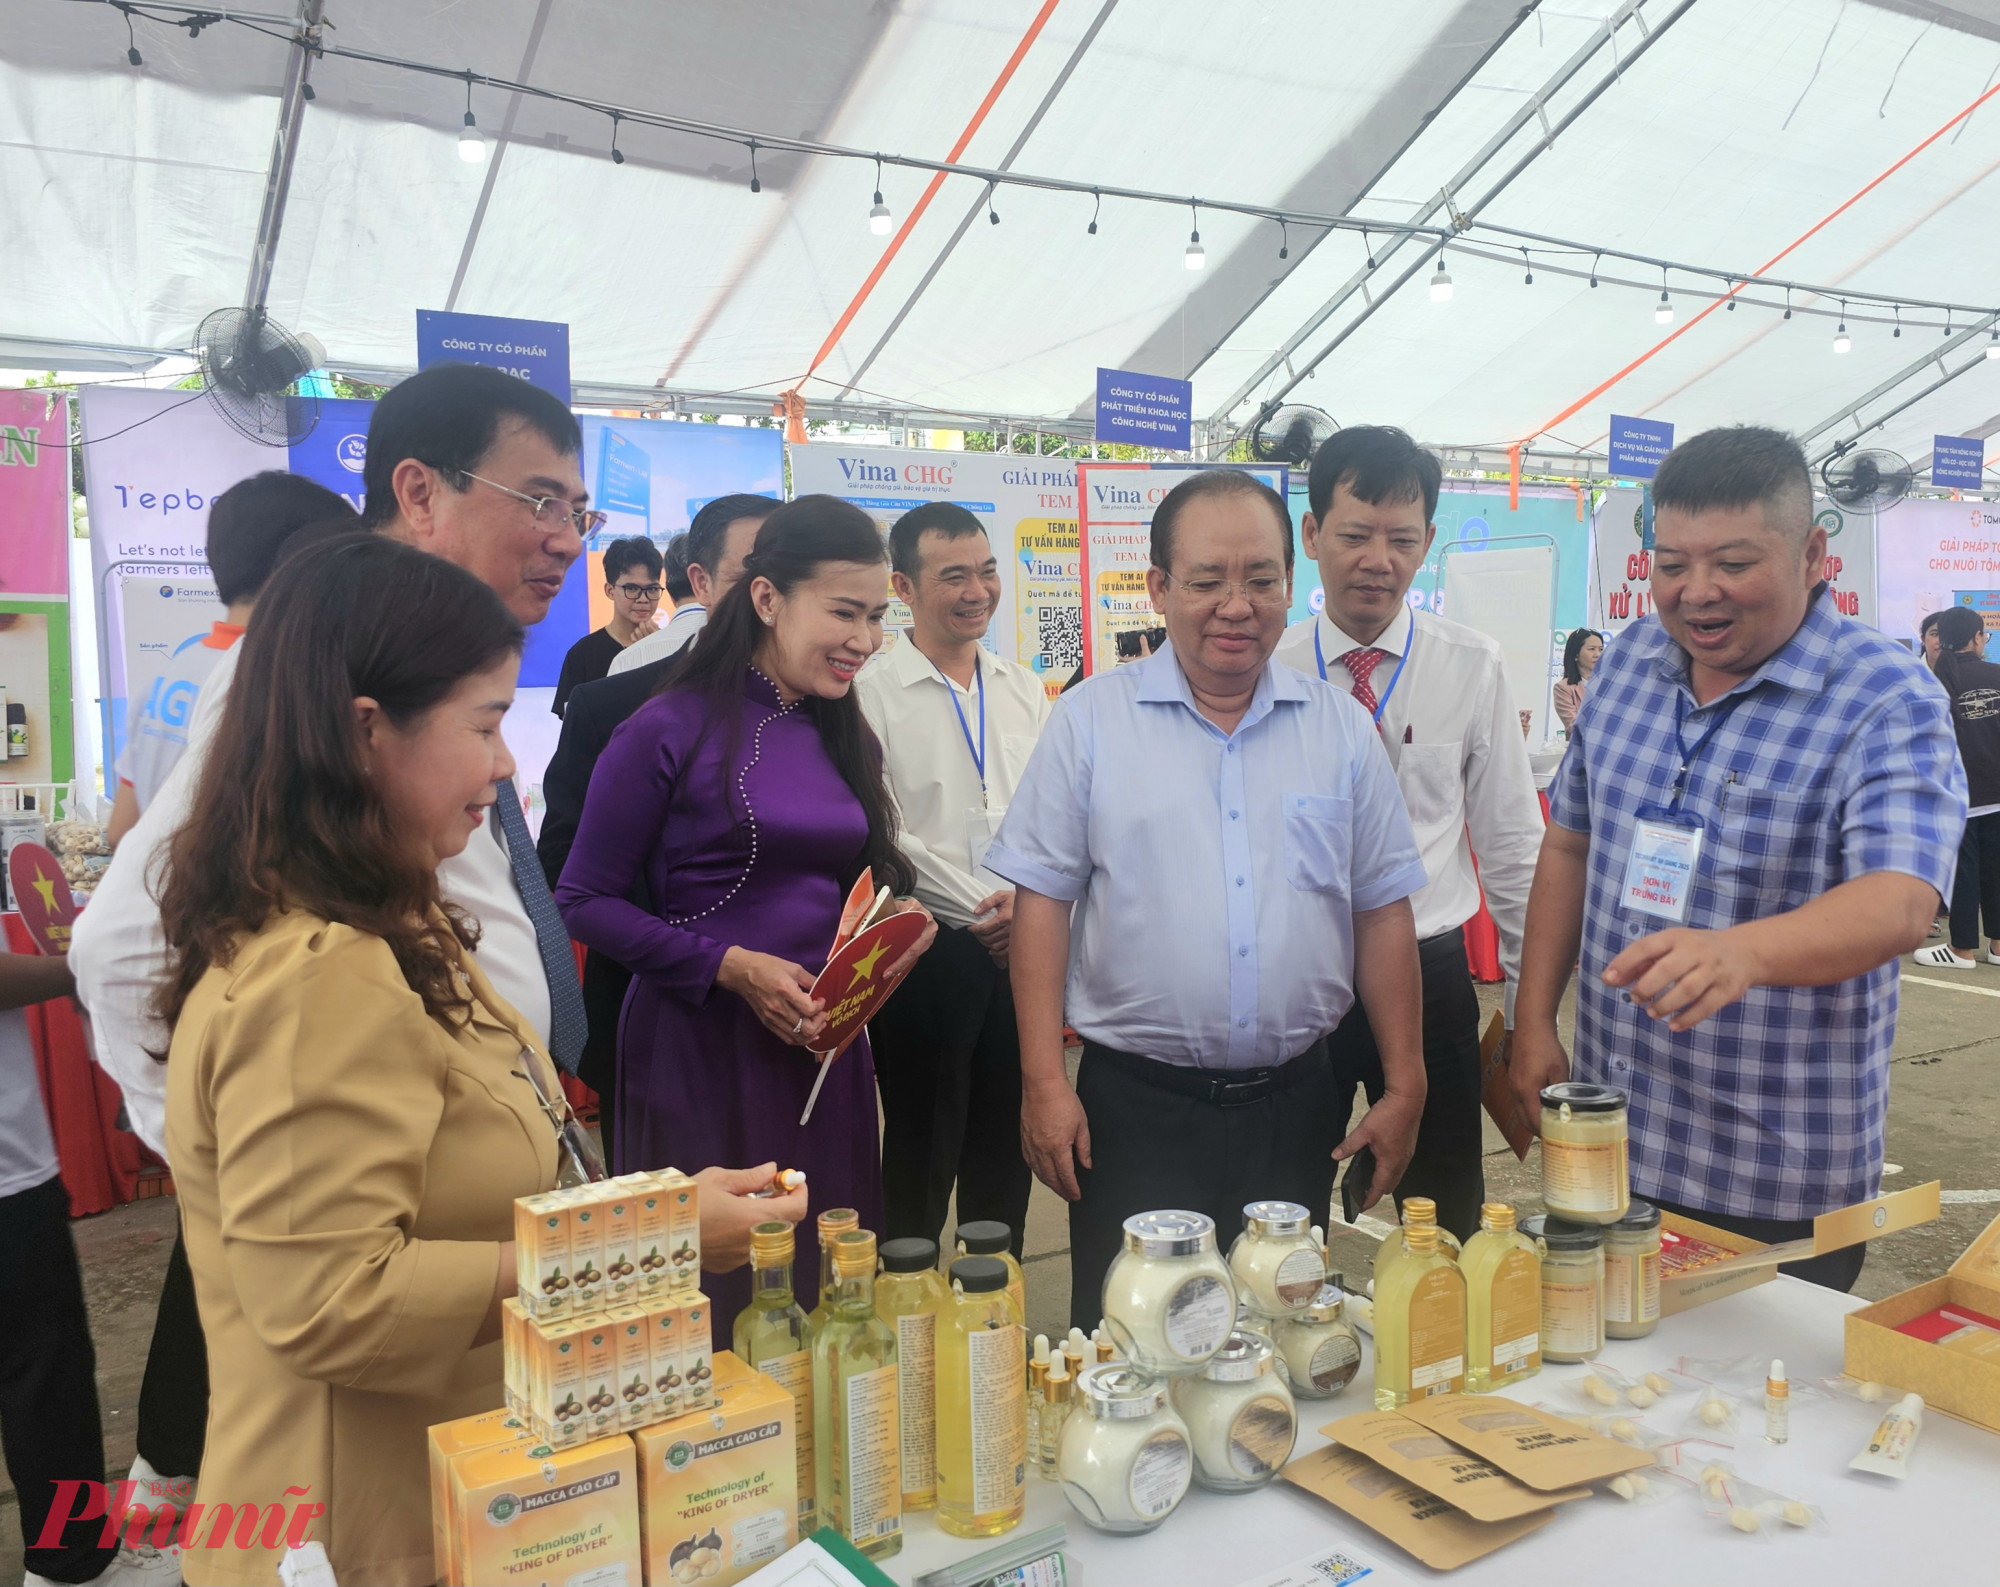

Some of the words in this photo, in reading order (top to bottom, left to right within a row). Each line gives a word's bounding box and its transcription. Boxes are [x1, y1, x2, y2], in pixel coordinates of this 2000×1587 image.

[442, 338, 476, 351] CÔNG
[478, 342, 493, 352] TY
[1110, 387, 1133, 398] CÔNG
[1135, 391, 1144, 399] TY
[1101, 401, 1122, 411] PHÁT
[1124, 403, 1147, 414] TRIỂN
[1147, 407, 1169, 417] KHOA
[1171, 411, 1187, 421] HỌC
[1112, 416, 1134, 426] CÔNG
[1136, 420, 1157, 431] NGHỆ
[1158, 423, 1177, 432] VINA
[1624, 430, 1639, 439] CÔNG
[1647, 434, 1661, 442] TNHH
[1613, 441, 1627, 449] DỊCH
[837, 457, 897, 482] Vina
[904, 464, 952, 485] CHG
[1002, 467, 1037, 486] GIẢI
[114, 485, 222, 516] Tepb
[1037, 493, 1072, 509] TEM
[1093, 485, 1141, 503] Vina
[1047, 522, 1066, 534] TEM
[1069, 523, 1078, 534] AI
[1020, 535, 1032, 547] TƯ
[1035, 533, 1053, 548] VẤN
[1056, 534, 1080, 548] HÀNG
[1093, 532, 1116, 545] GIẢI
[1119, 532, 1147, 545] PHÁP
[1940, 536, 1960, 551] GIẢI
[1963, 538, 1989, 552] PHÁP
[119, 543, 155, 556] Let's
[160, 545, 185, 557] not
[1113, 552, 1137, 561] TEM
[1024, 560, 1063, 576] Vina
[1627, 549, 1652, 581] CÔ
[1929, 558, 1950, 570] CHO
[1953, 557, 1978, 571] NUÔI
[1120, 573, 1134, 581] TEM
[1136, 573, 1143, 581] AI
[1126, 582, 1146, 591] HÀNG
[893, 609, 911, 617] Vina
[1103, 600, 1132, 610] Vina
[826, 998, 852, 1022] VIỆT
[850, 984, 876, 1009] NAM
[698, 1439, 734, 1456] MACCA
[736, 1431, 757, 1445] CAO
[759, 1423, 779, 1437] CẤP
[526, 1490, 567, 1509] MACCA
[569, 1482, 592, 1497] CAO
[595, 1473, 617, 1488] CẤP
[686, 1478, 751, 1504] Technology
[753, 1471, 766, 1484] of
[677, 1502, 713, 1520] "KING
[715, 1496, 730, 1508] OF
[732, 1482, 774, 1503] DRYER"
[512, 1530, 587, 1559] Technology
[590, 1523, 604, 1537] of
[502, 1557, 543, 1575] "KING
[546, 1551, 563, 1564] OF
[566, 1534, 613, 1558] DRYER"
